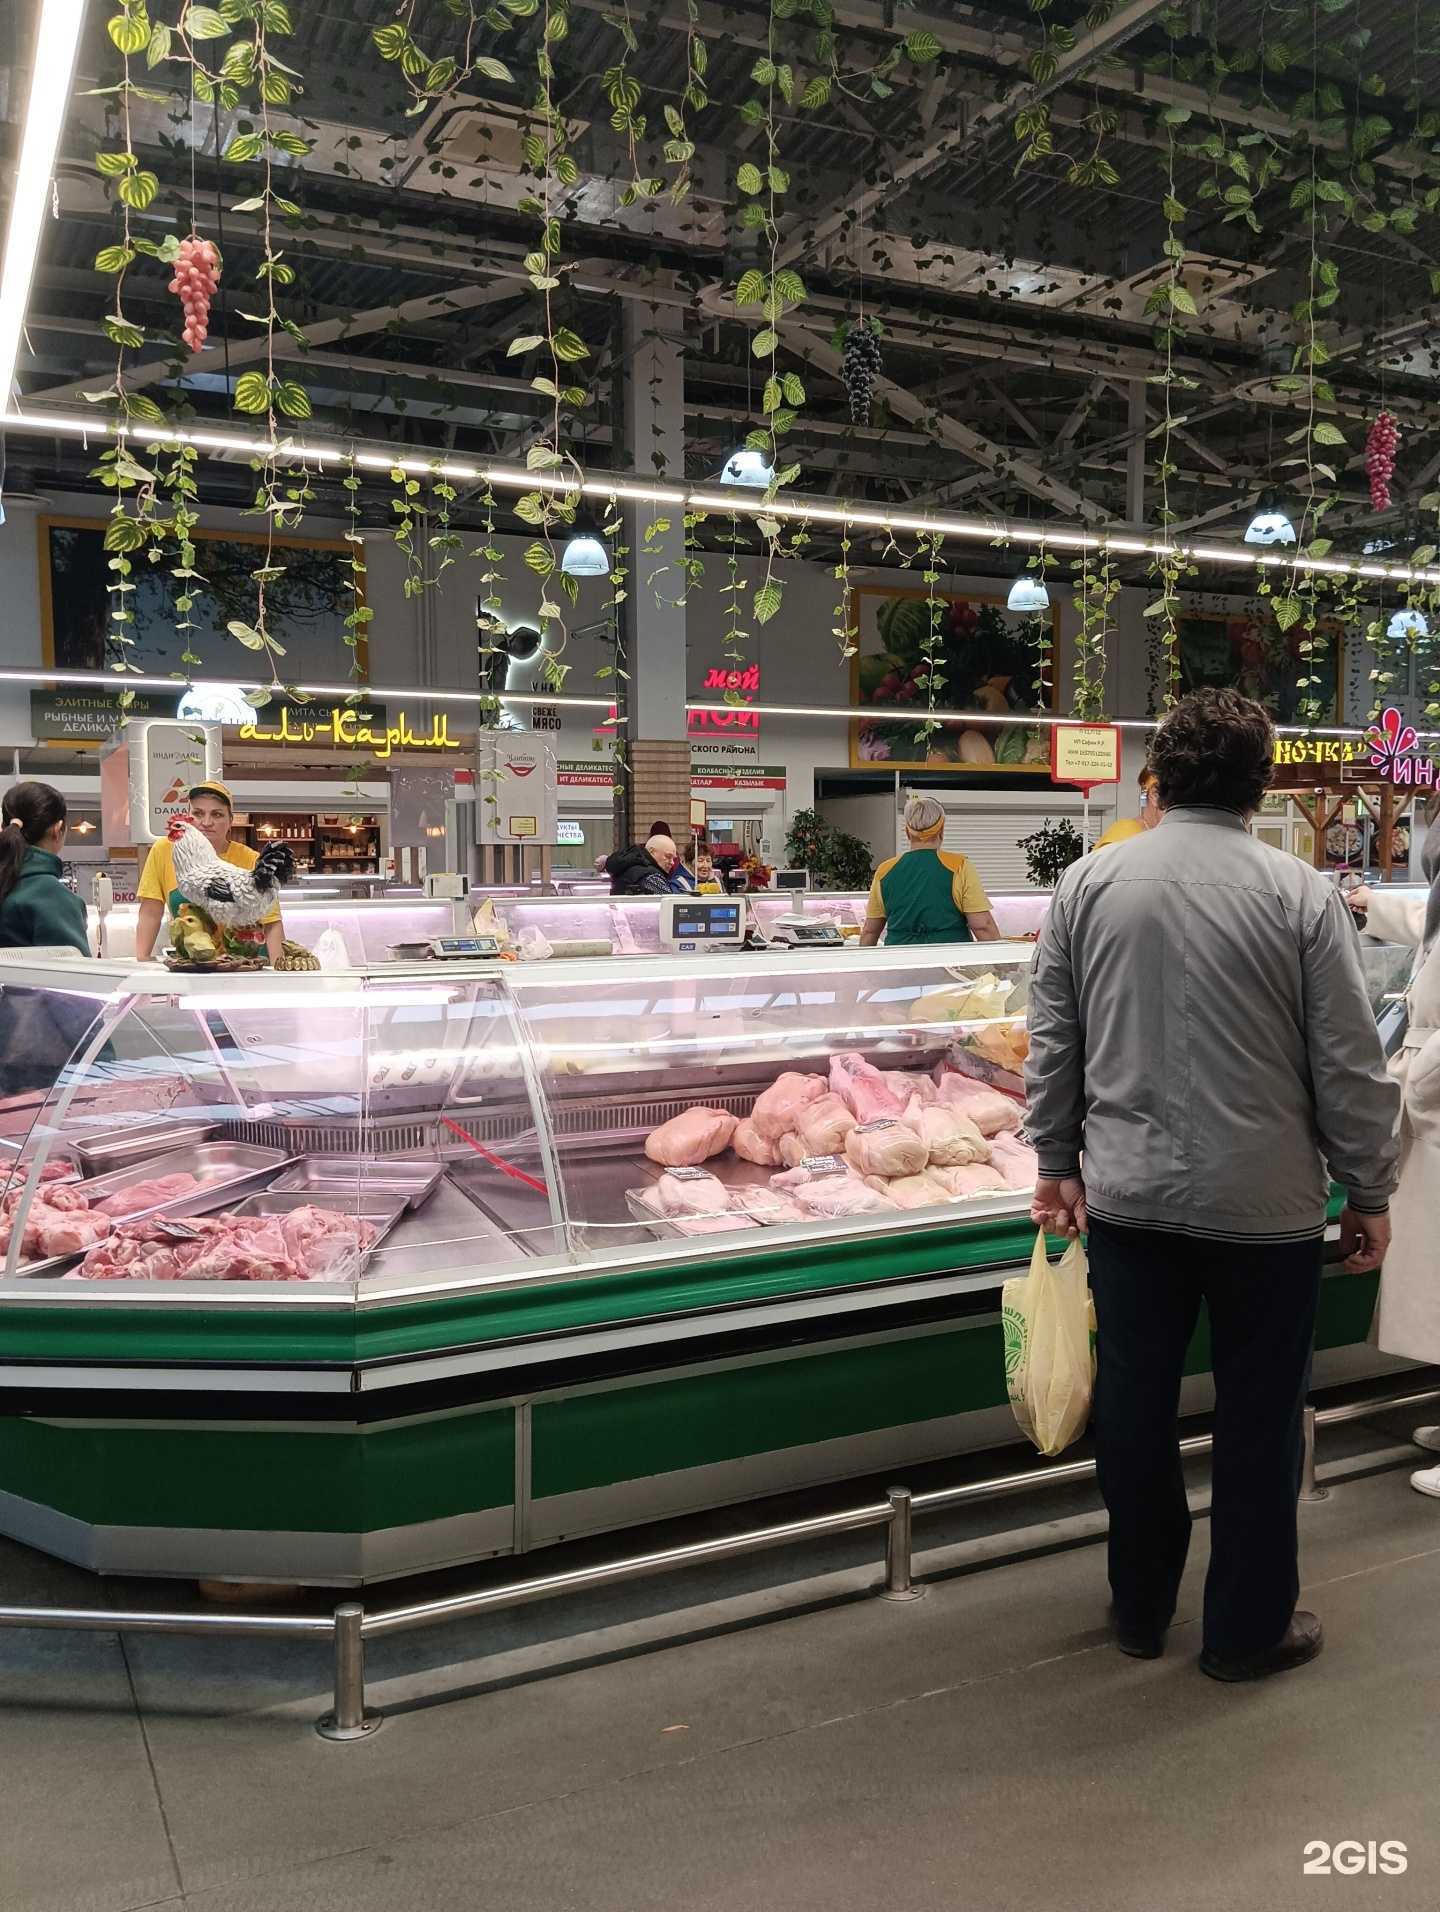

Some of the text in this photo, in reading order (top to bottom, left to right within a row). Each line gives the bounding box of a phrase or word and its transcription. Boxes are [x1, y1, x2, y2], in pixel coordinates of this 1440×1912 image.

[541, 682, 555, 694] НА
[55, 697, 150, 710] ЭЛИТНЫЕ СРЫ
[44, 711, 93, 723] РЫБНЫЕ
[96, 714, 105, 723] И
[532, 718, 562, 730] МЯСО
[721, 744, 756, 755] РАЙОНА
